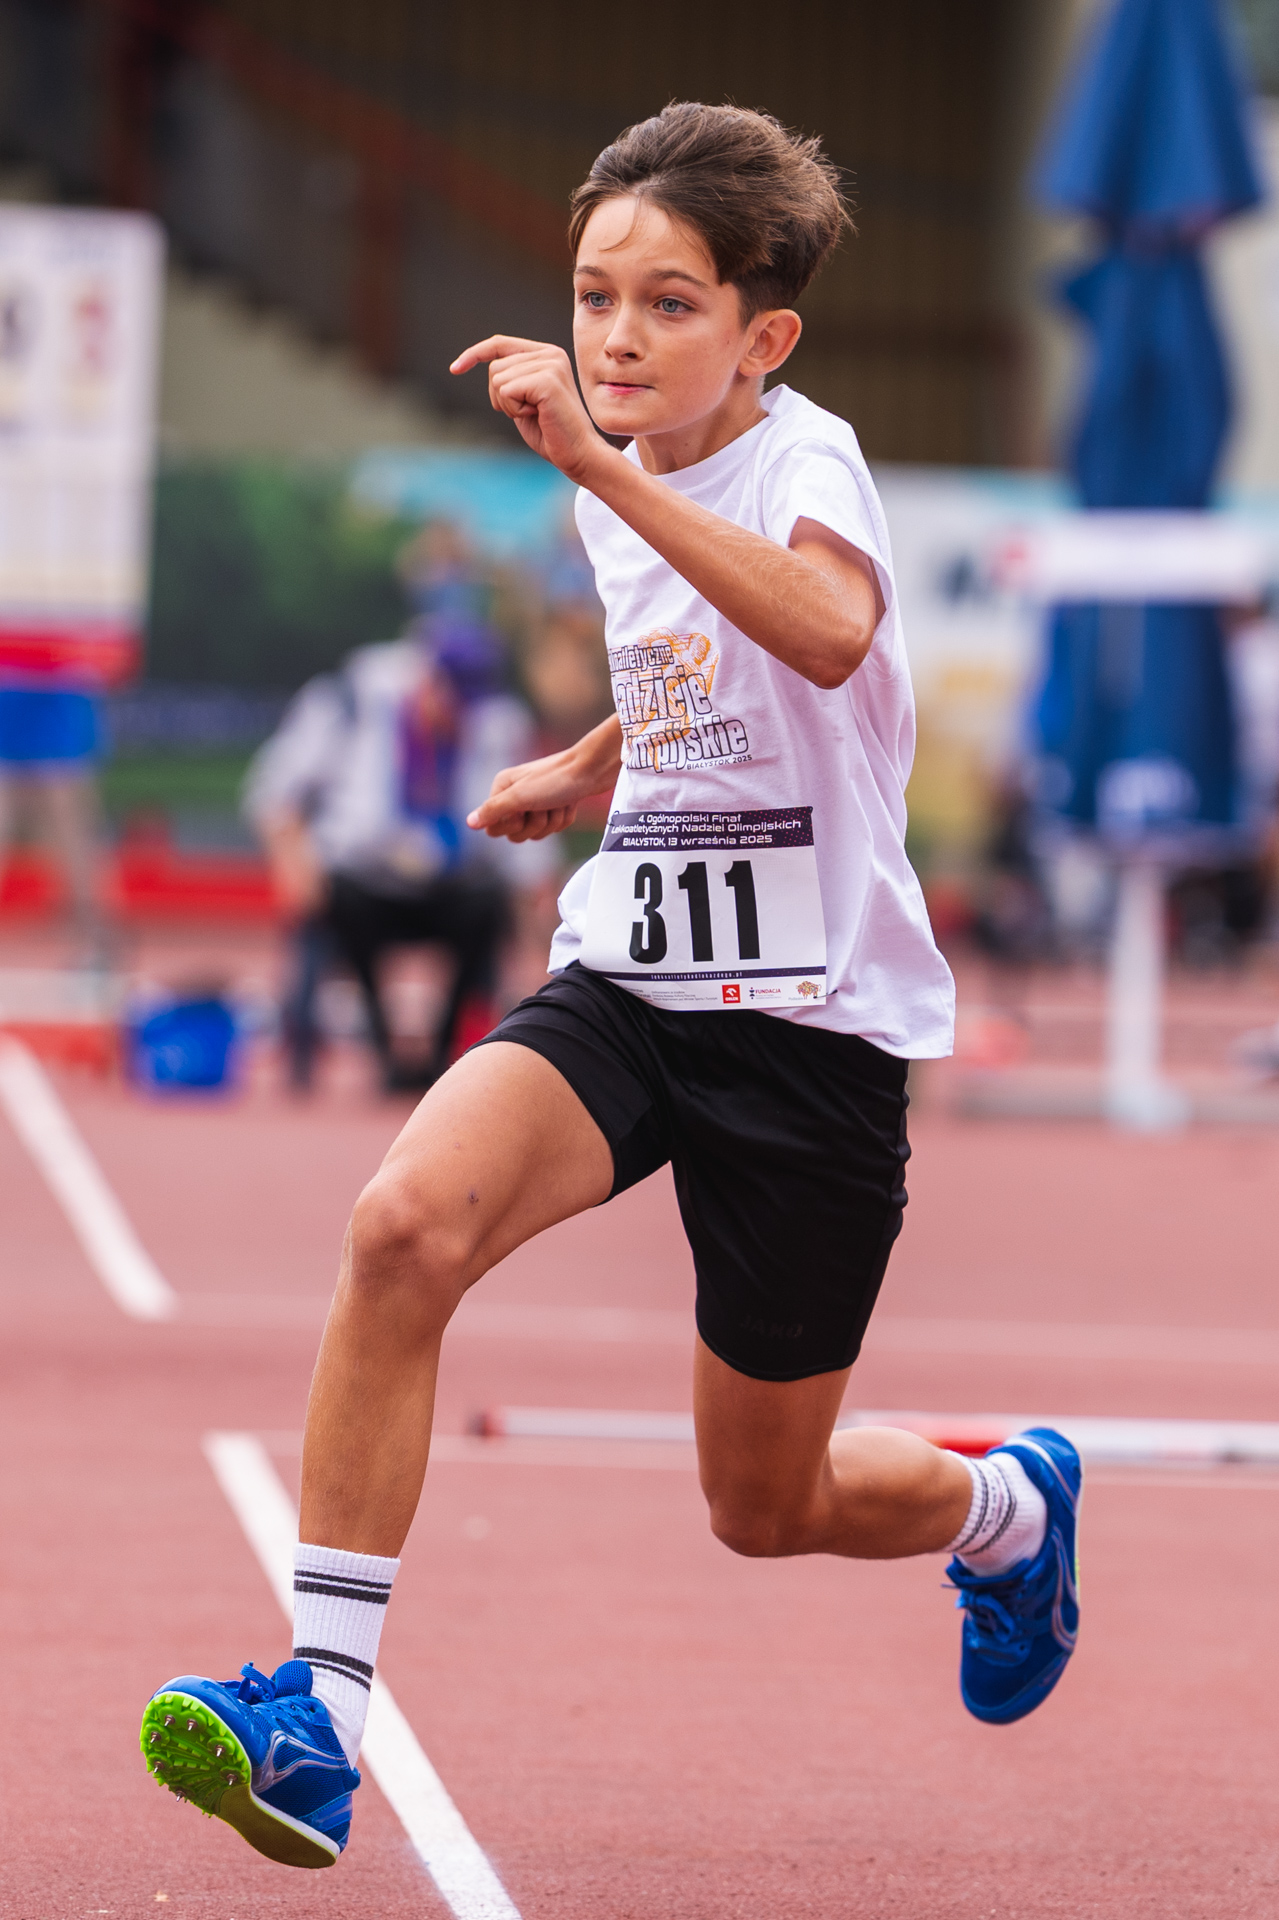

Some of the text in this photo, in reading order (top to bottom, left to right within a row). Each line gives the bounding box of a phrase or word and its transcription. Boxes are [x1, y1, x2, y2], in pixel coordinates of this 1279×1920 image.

[611, 665, 713, 726] adzieje
[686, 754, 753, 770] BIAŁYSTOK 2025
[611, 819, 802, 835] Lekkoatletycznych Nadziei Olimpijskich
[646, 813, 709, 826] Ogólnopolski
[711, 814, 742, 823] Finał
[622, 834, 773, 848] BIAŁYSTOK, 13 września 2025
[629, 860, 761, 964] 311
